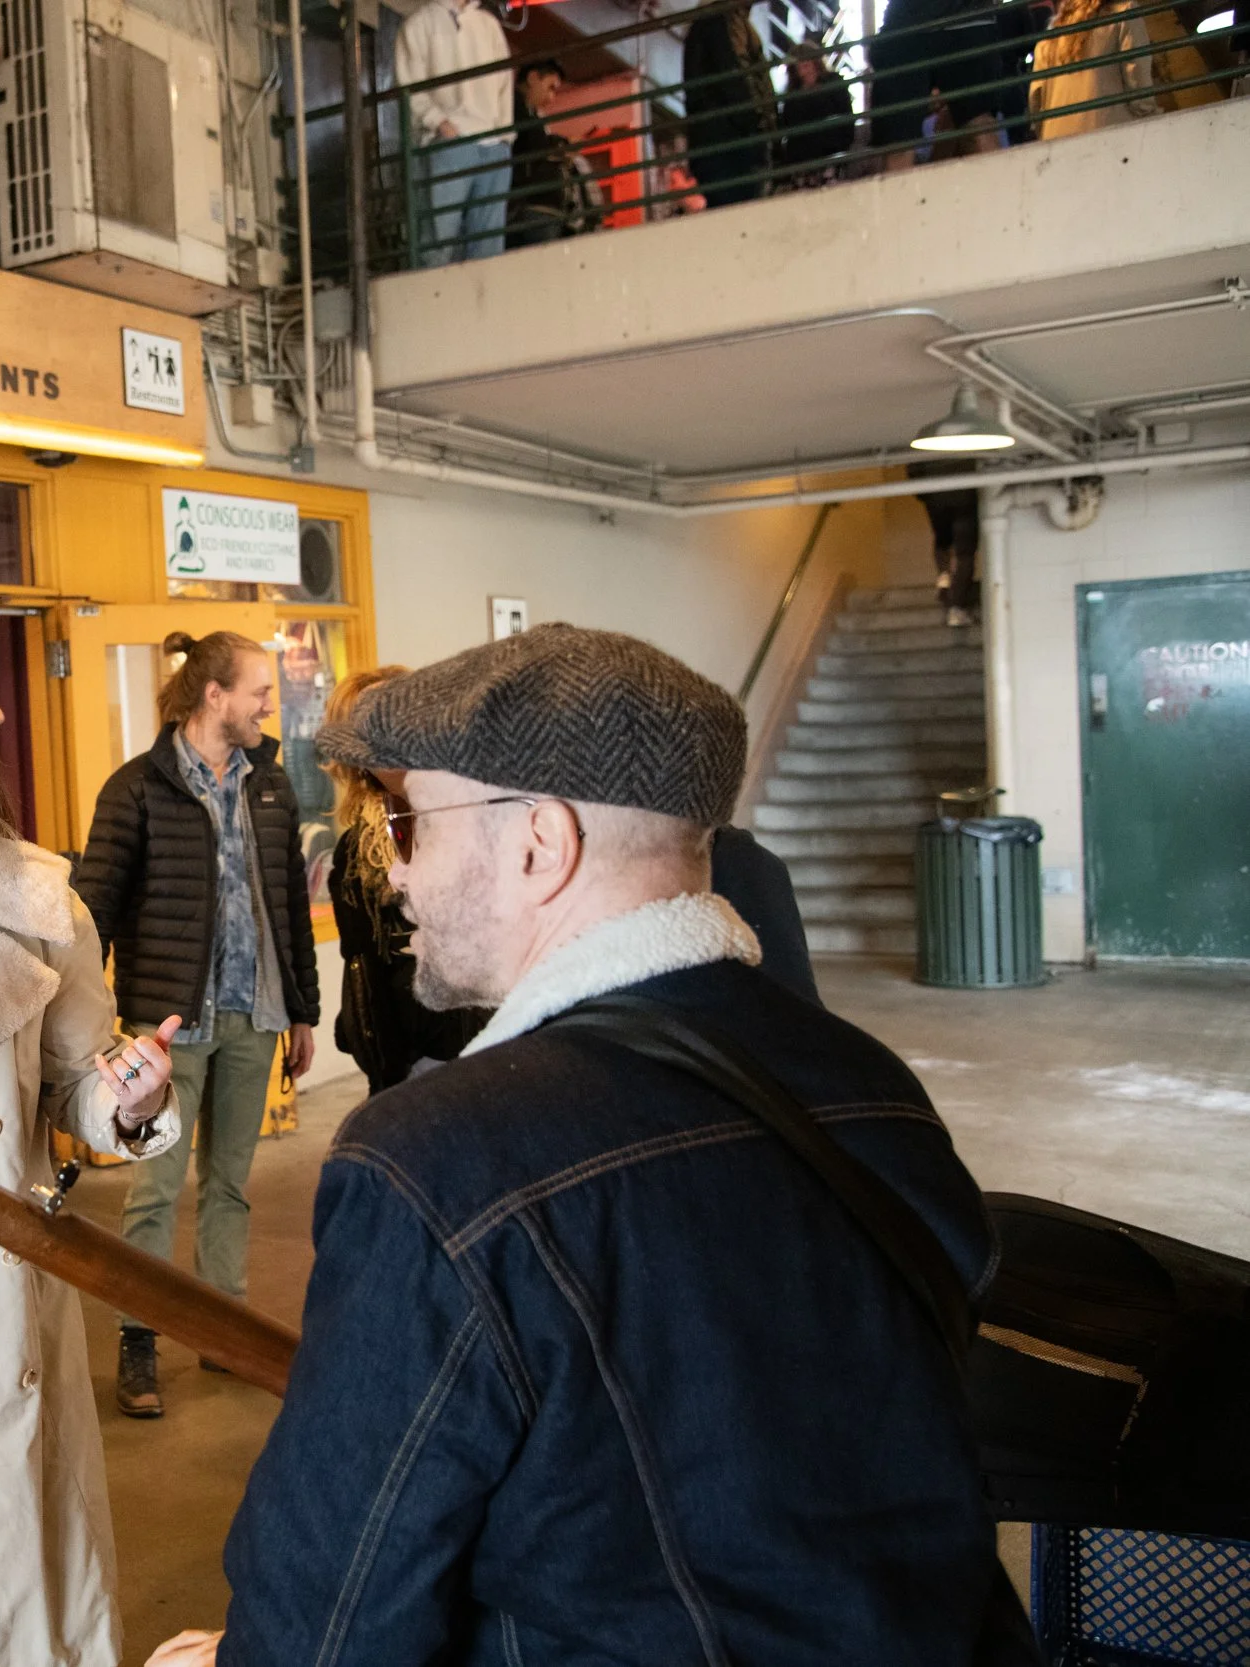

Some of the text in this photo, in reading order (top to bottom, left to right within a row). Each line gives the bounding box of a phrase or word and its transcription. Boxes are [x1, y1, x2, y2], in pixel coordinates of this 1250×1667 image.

[196, 503, 295, 533] CONSCIOUS WEAR
[1139, 640, 1249, 662] CAUTION
